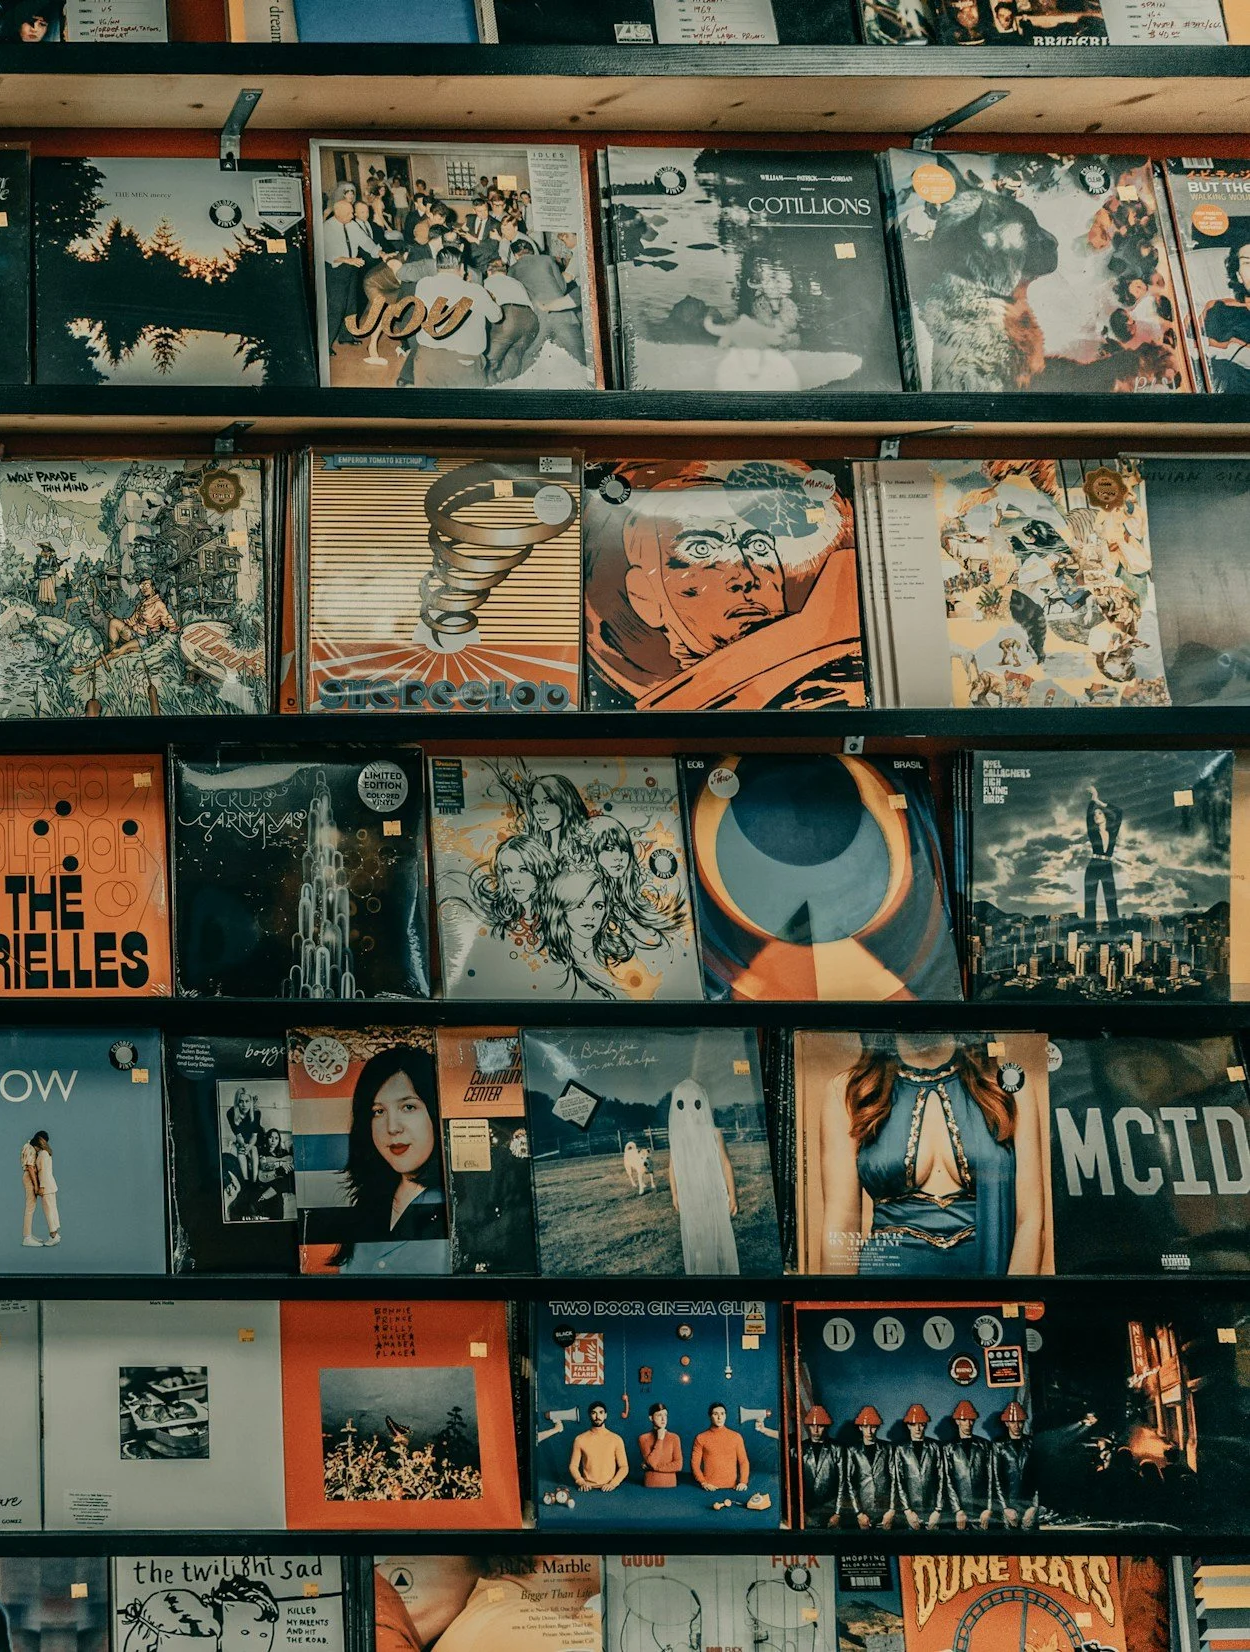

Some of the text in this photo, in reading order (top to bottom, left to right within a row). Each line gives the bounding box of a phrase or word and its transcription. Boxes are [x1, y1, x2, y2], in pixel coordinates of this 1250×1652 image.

[151, 192, 172, 200] mercy
[748, 197, 871, 215] COTILLIONS
[345, 296, 473, 338] JOY
[395, 457, 423, 465] KETCHUP
[7, 471, 77, 483] WOLF PARADE
[41, 483, 88, 493] THIN MIND
[687, 761, 705, 769] EOB
[894, 761, 923, 769] BRASIL
[364, 772, 402, 780] LIMITED
[983, 778, 1002, 786] HIGH
[364, 782, 402, 790] EDITION
[983, 786, 1008, 795] FLYING
[198, 785, 280, 809] PICKUPS
[983, 795, 1005, 804] BIRDS
[178, 808, 307, 849] CARNAVAS
[5, 875, 84, 931] THE
[245, 1042, 287, 1067] boyge
[310, 1044, 343, 1075] 2019
[306, 1056, 332, 1081] DACUS
[0, 1070, 78, 1102] OW
[463, 1086, 503, 1102] CENTER
[1055, 1106, 1250, 1196] MCID
[866, 1232, 904, 1240] LEWIS
[375, 1307, 411, 1315] BONNIE
[549, 1300, 765, 1316] TWO DOOR CINEMA CLUB
[1131, 1325, 1145, 1366] NEON
[499, 1559, 591, 1575] Black Marble
[772, 1555, 820, 1568] FUCK
[133, 1555, 323, 1585] the twilight sad
[521, 1589, 593, 1602] Bigger Than Life
[911, 1555, 1116, 1630] DUNE RATS
[287, 1606, 317, 1615] KILLED
[286, 1619, 329, 1628] MY PARENTS
[286, 1628, 303, 1636] AND
[286, 1636, 329, 1645] THE ROAD.
